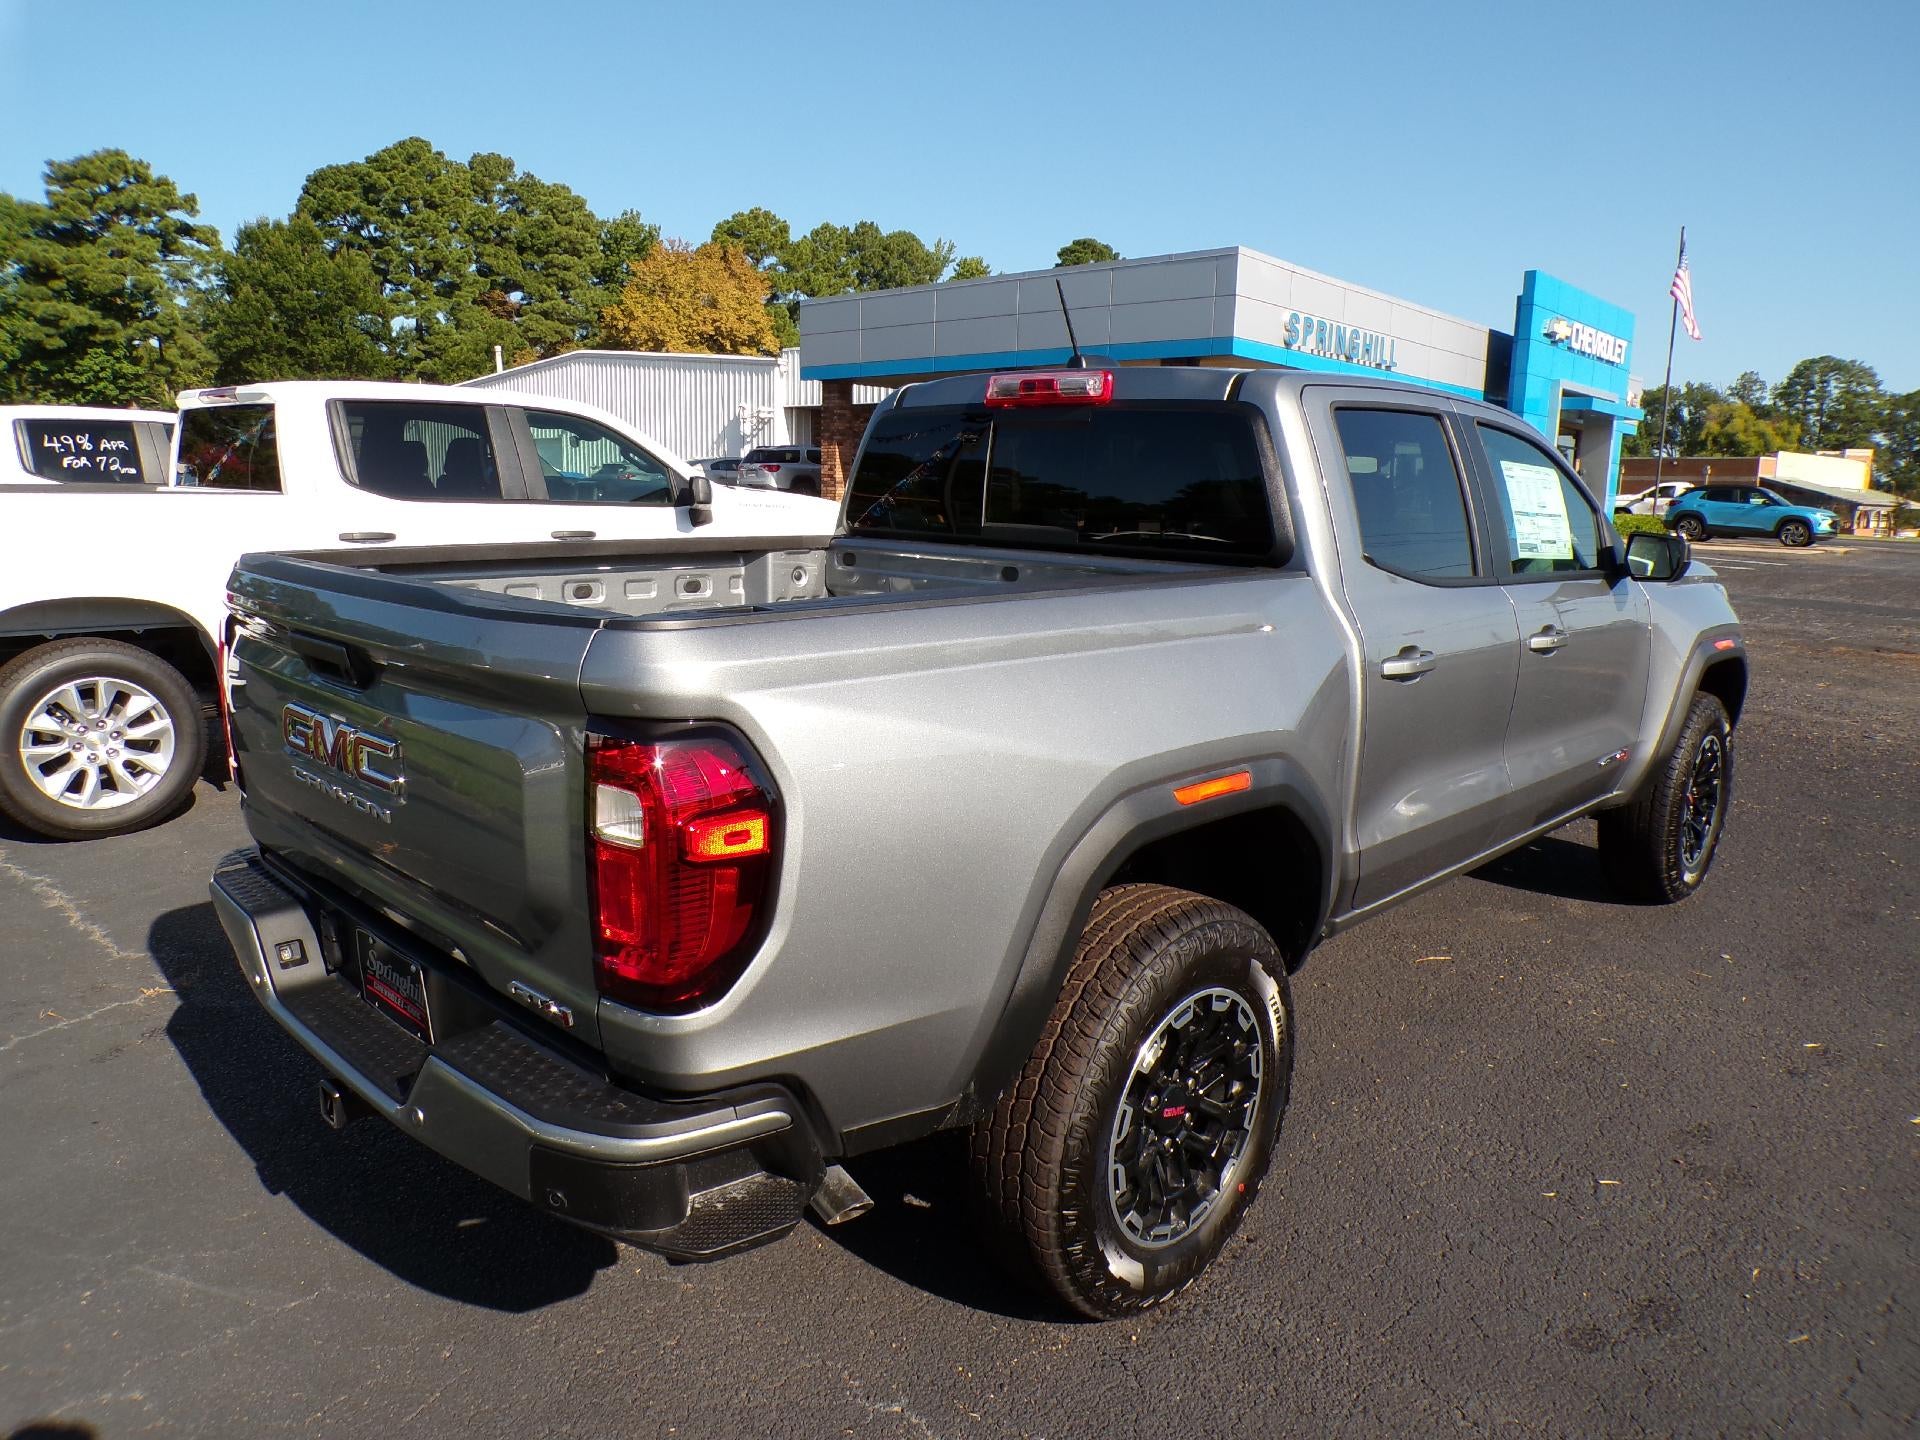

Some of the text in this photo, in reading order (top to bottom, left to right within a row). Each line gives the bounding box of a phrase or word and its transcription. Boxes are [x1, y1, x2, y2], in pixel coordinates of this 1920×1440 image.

[1285, 311, 1398, 368] SPRINGHILL
[1571, 321, 1628, 365] CHEVROLET
[44, 433, 129, 453] 4.9% APR
[62, 456, 92, 469] FOR
[282, 701, 405, 794] GMC
[1163, 1105, 1186, 1118] GMC
